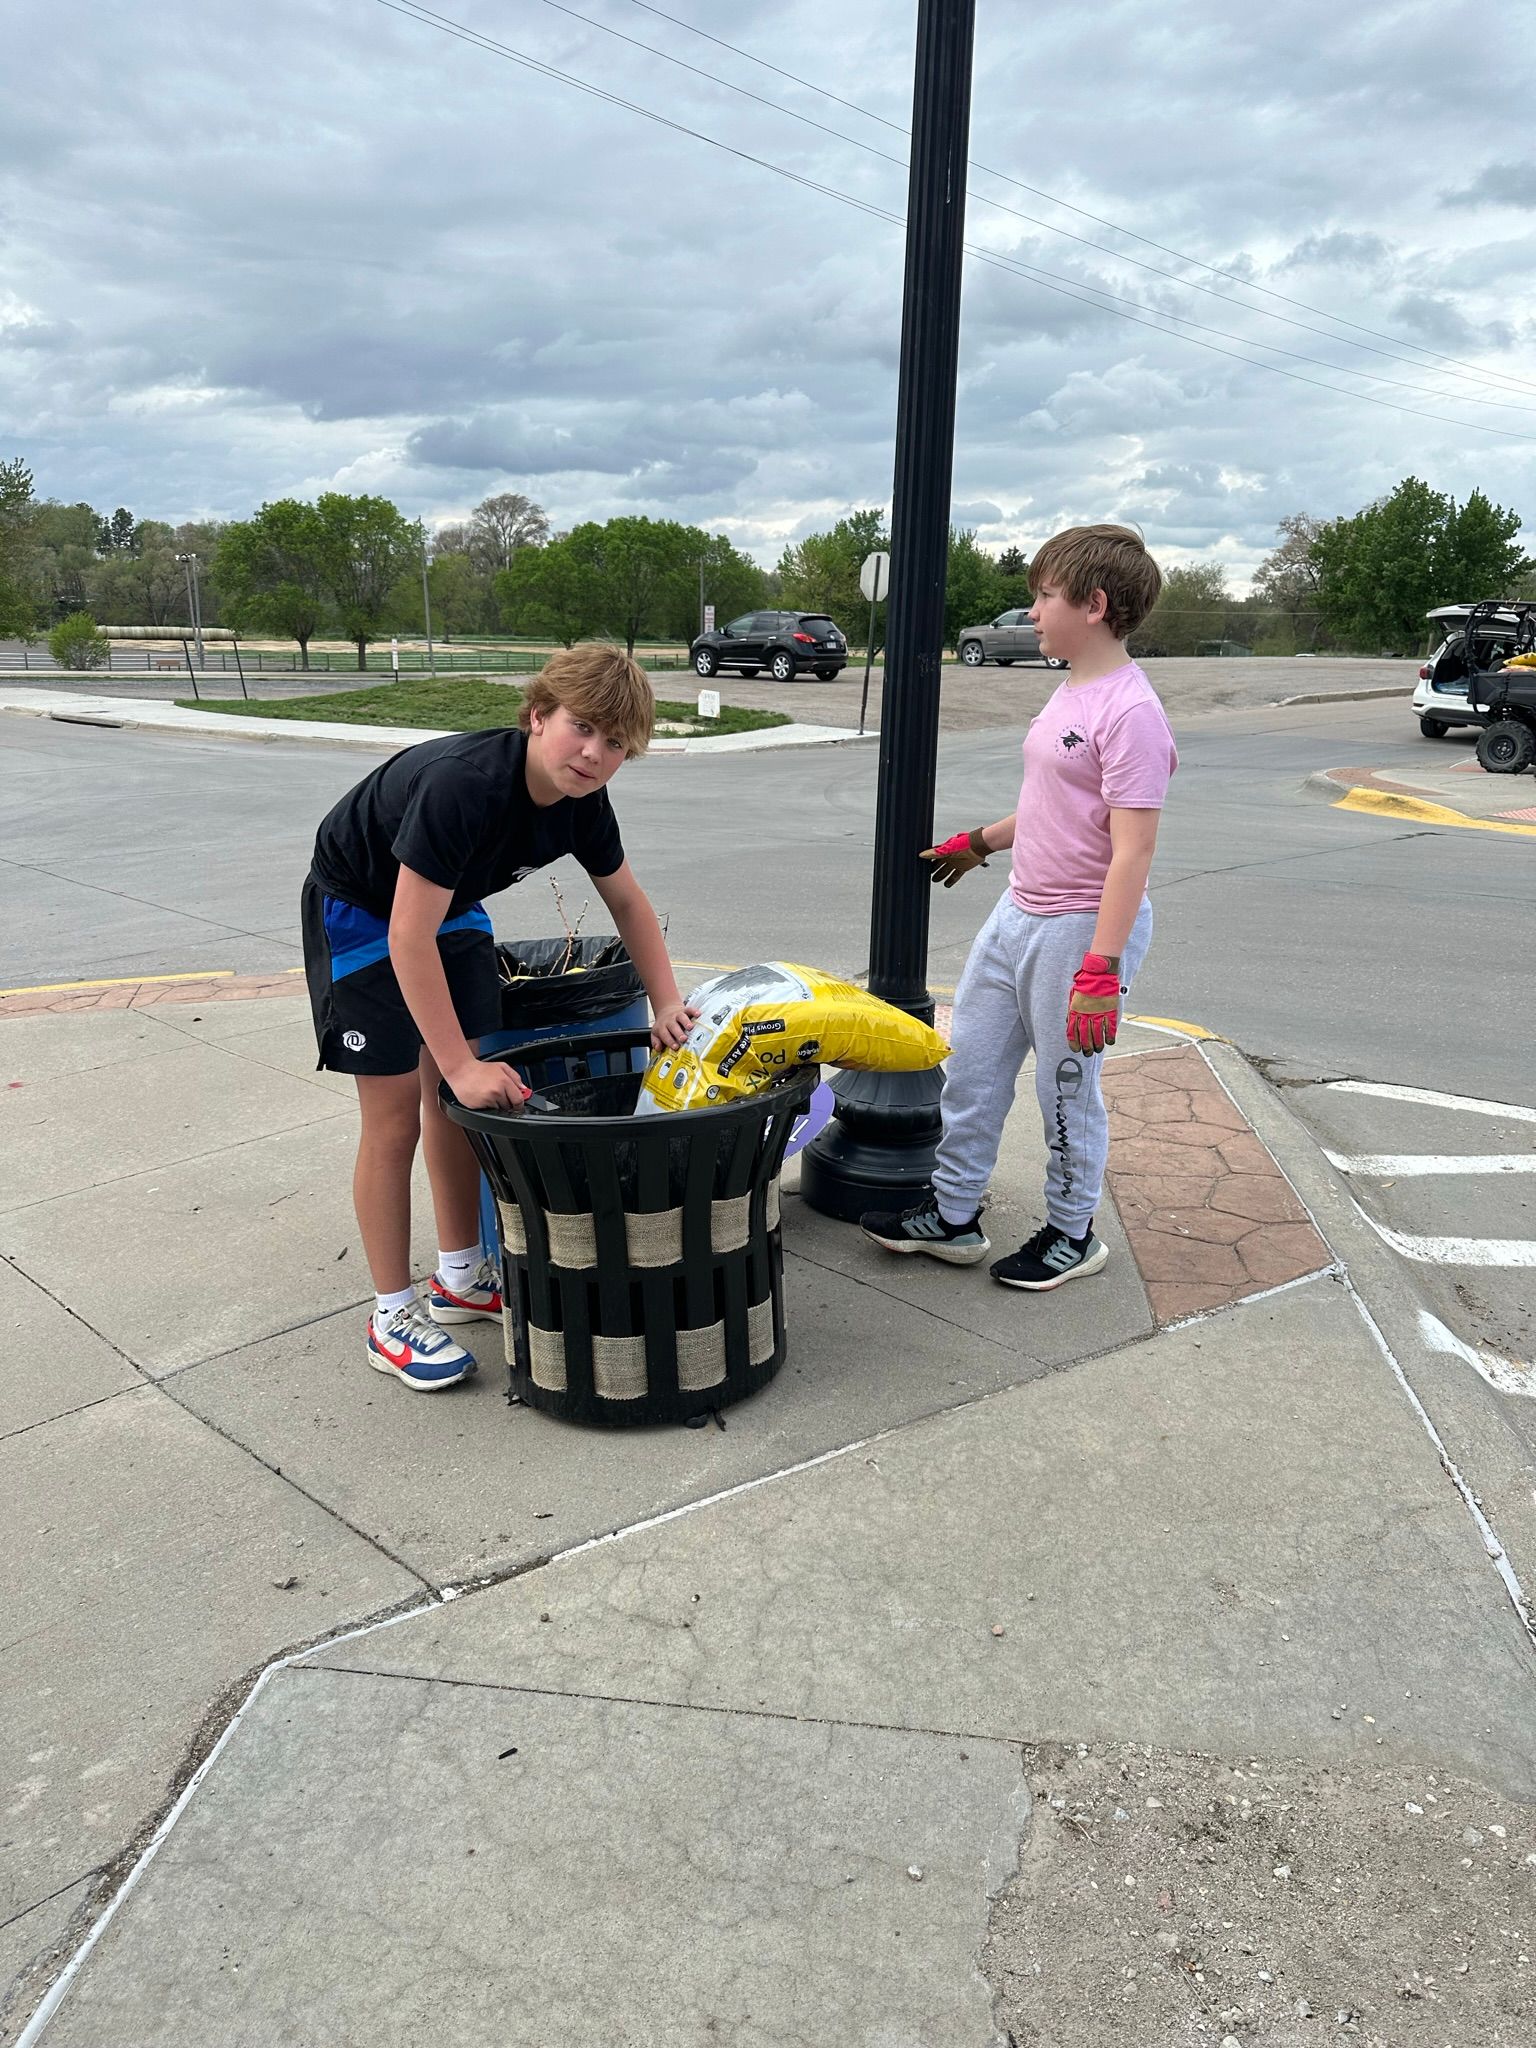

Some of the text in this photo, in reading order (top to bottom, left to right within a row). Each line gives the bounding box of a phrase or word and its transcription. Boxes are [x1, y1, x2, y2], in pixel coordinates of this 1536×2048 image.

[756, 1022, 781, 1031] Grows
[732, 1048, 741, 1059] As
[1050, 1057, 1083, 1199] Champion
